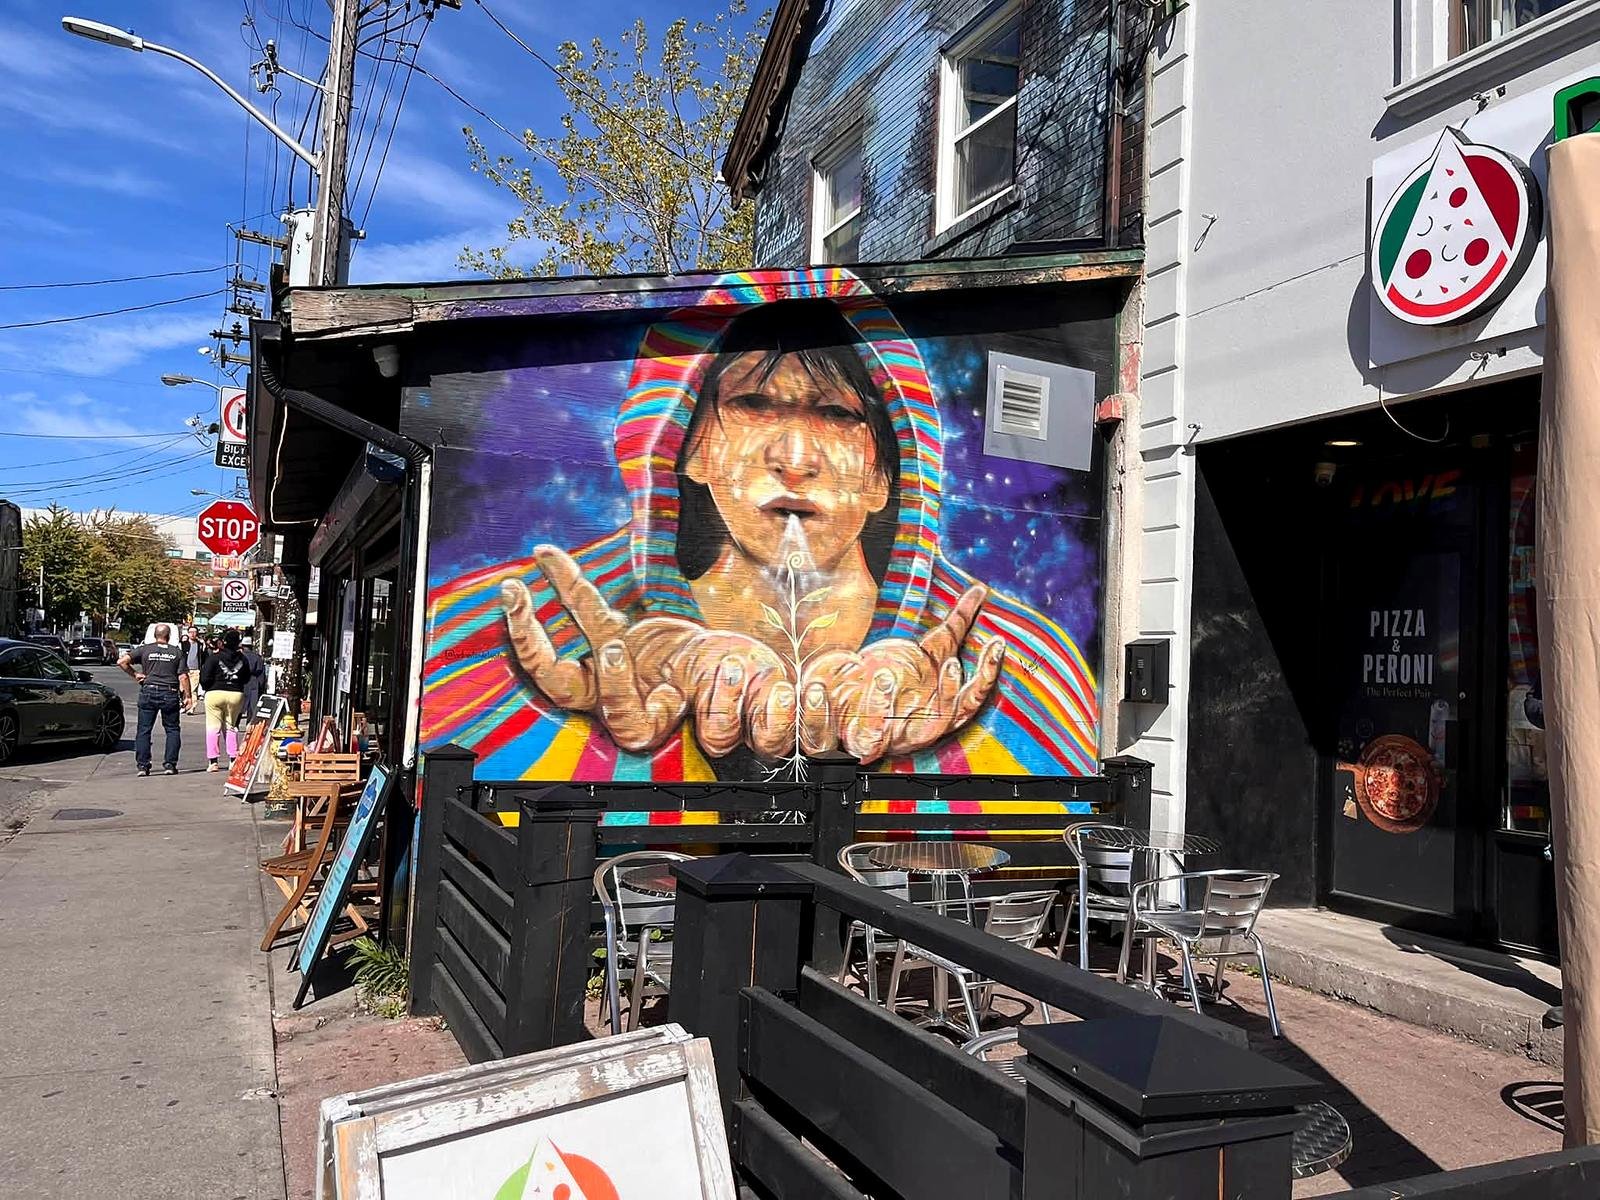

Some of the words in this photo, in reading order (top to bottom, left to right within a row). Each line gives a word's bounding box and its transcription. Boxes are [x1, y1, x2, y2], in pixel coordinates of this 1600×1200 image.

[201, 517, 256, 540] STOP
[1370, 609, 1426, 638] PIZZA
[1392, 639, 1402, 653] &
[1363, 654, 1434, 686] PERONI
[1366, 687, 1381, 697] The
[1383, 687, 1412, 698] Perfect
[1415, 688, 1431, 699] Pair
